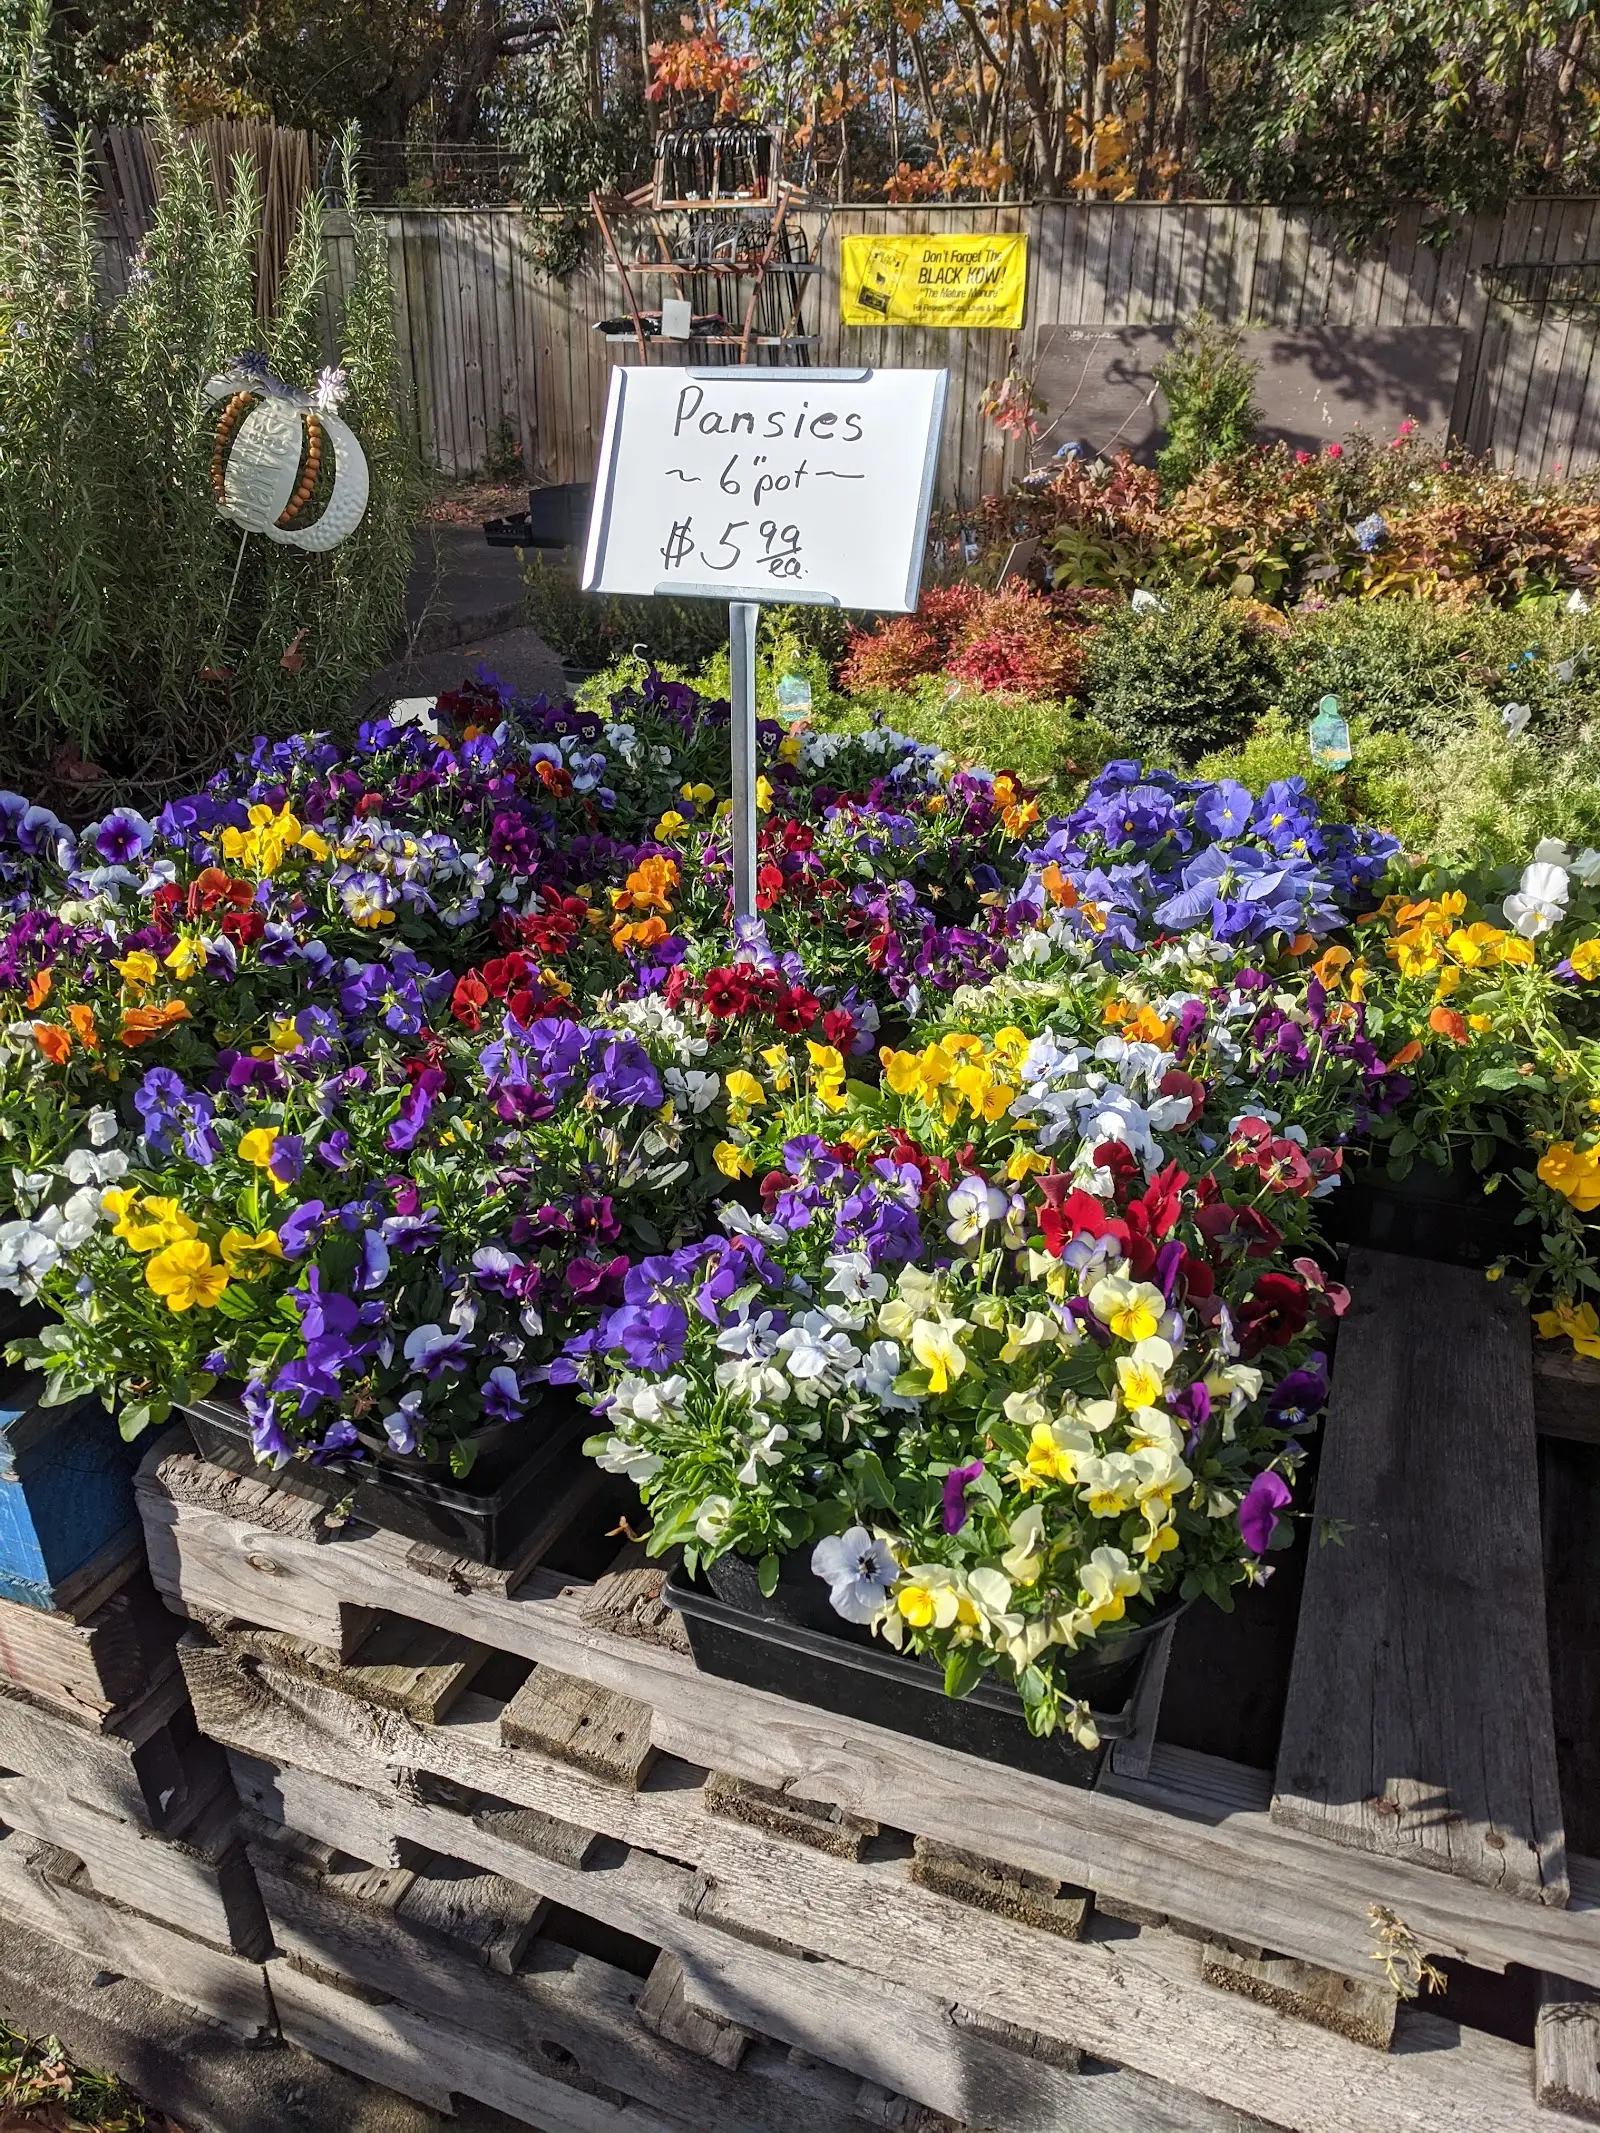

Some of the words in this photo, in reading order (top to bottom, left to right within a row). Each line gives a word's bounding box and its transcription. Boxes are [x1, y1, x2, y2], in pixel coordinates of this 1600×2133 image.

[923, 250, 948, 263] Don't
[950, 250, 983, 265] Forget
[986, 249, 1003, 263] The
[918, 267, 962, 284] BLACK
[966, 267, 1007, 284] KOW!
[940, 288, 966, 298] Mature
[673, 385, 864, 442] Pansies
[753, 459, 809, 507] pot
